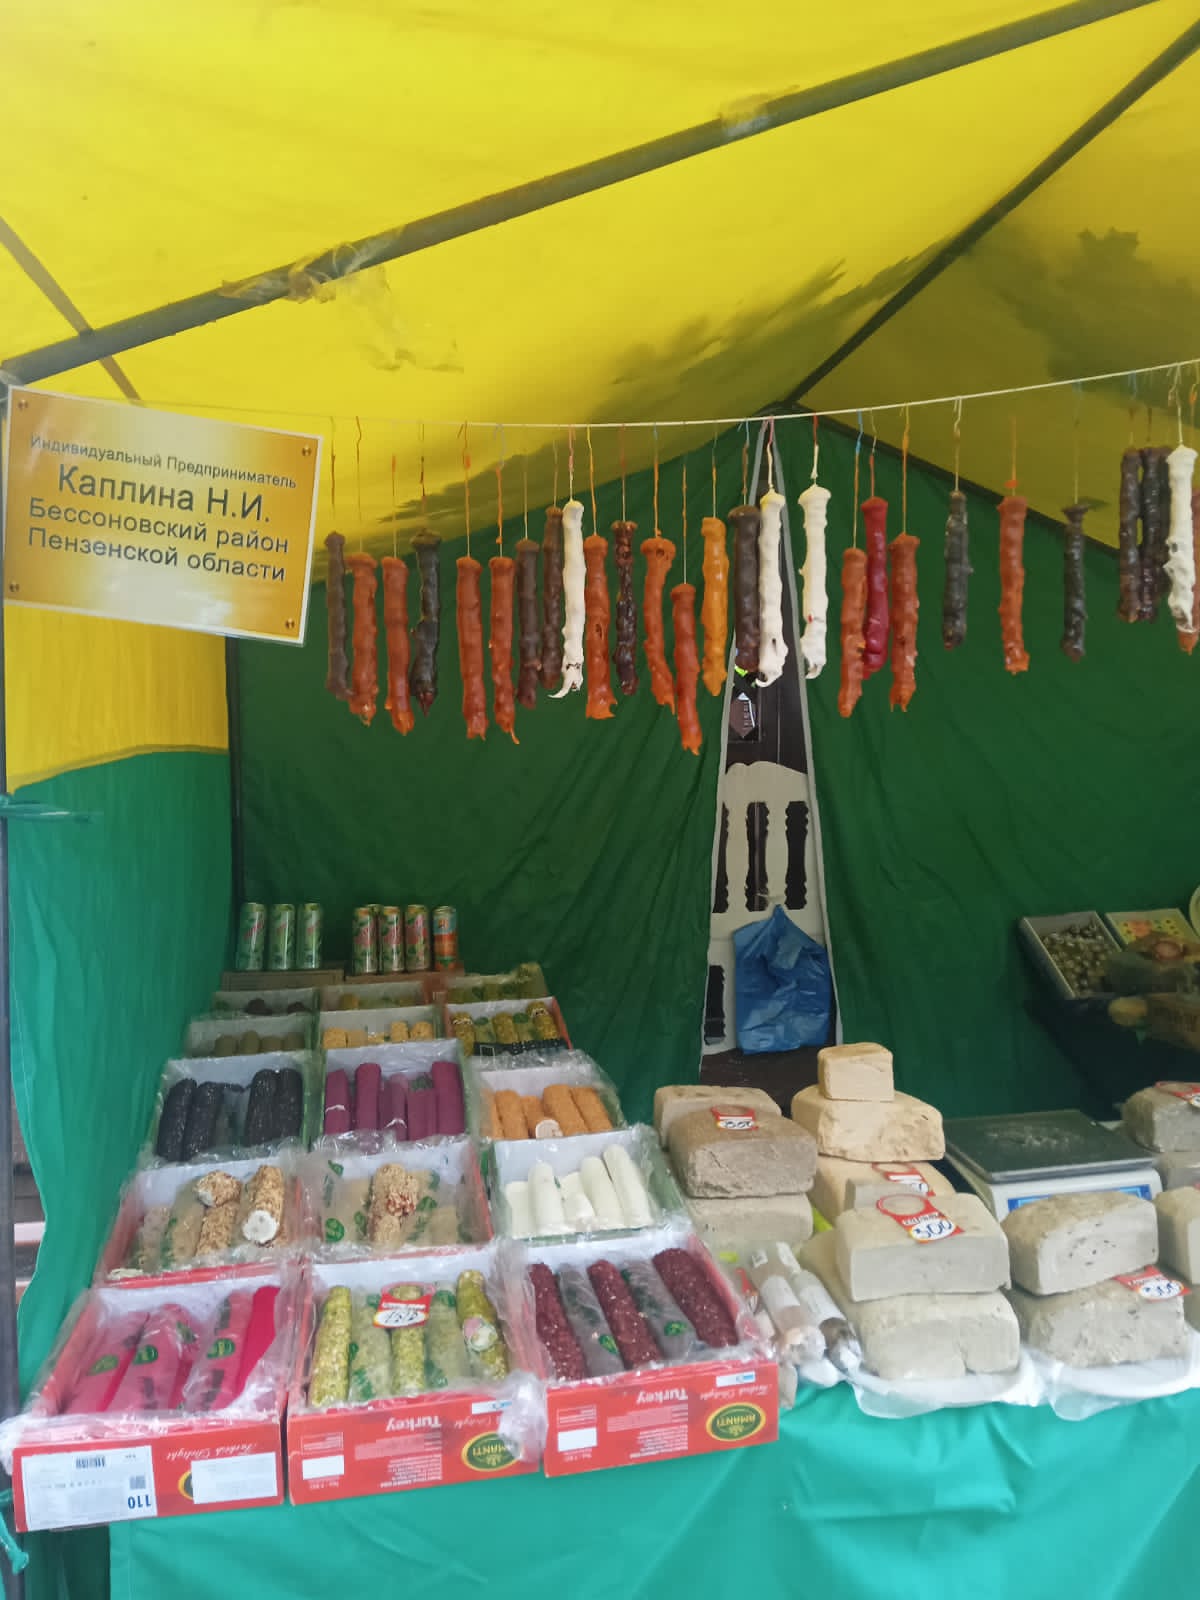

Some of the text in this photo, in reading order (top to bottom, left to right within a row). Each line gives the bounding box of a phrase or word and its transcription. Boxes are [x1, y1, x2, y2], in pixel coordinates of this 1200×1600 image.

[30, 434, 297, 489] Индивидуальный Предприниматель
[58, 463, 270, 522] Каплина Н.И.
[29, 497, 289, 554] Бессоновский район
[28, 527, 286, 582] Пензенской области
[636, 1388, 688, 1404] Turkey
[386, 1415, 442, 1432] Turkey
[716, 1414, 756, 1428] AMANTI
[128, 1494, 151, 1509] 110
